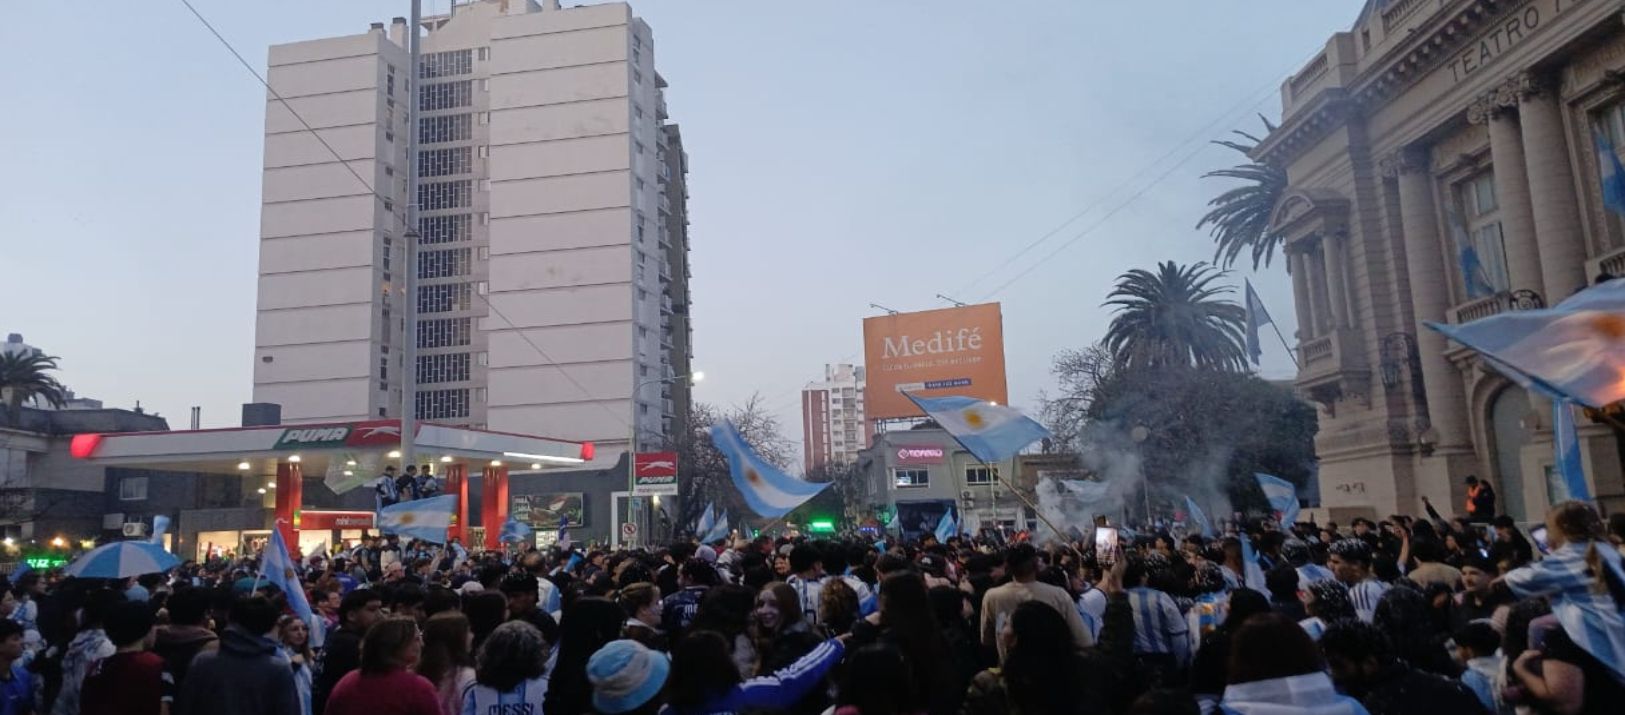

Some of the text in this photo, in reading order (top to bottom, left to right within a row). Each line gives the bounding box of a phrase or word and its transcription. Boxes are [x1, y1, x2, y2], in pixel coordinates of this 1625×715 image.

[1447, 6, 1539, 82] TEATRO
[881, 327, 983, 359] Medifé
[283, 426, 349, 443] PUMA
[638, 475, 674, 484] PUMA
